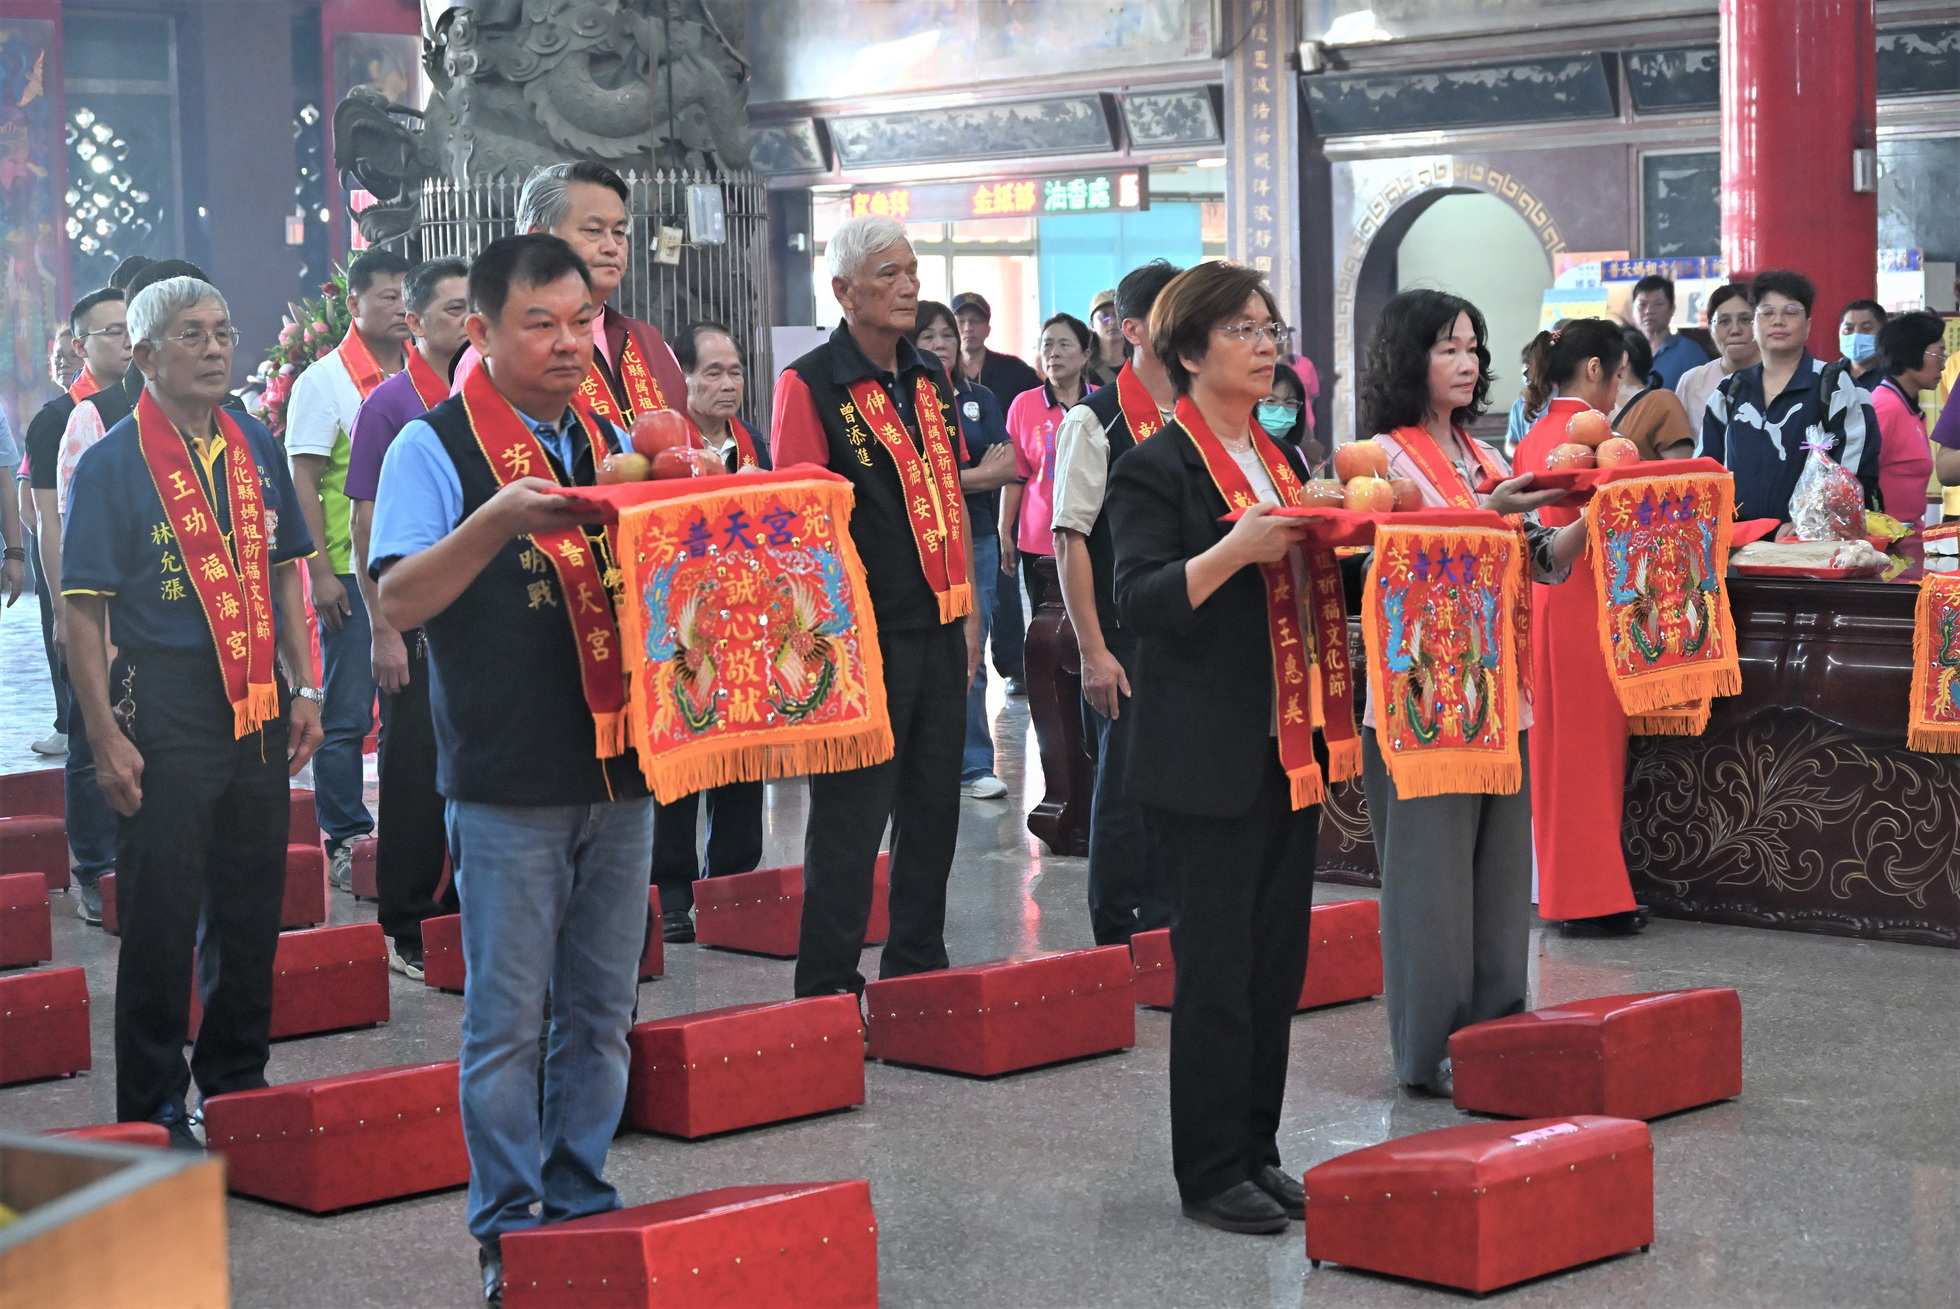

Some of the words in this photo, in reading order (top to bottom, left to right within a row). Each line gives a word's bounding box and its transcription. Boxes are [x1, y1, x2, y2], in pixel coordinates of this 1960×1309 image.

[840, 401, 874, 467] 曾添進
[866, 389, 939, 554] 伸港福安宮
[915, 377, 961, 543] 彰化縣媽祖祈福文化節
[151, 521, 187, 601] 林允漲
[168, 470, 248, 660] 王功福海宮
[233, 445, 271, 641] 彰化縣媽祖祈福文化節
[517, 533, 557, 610] 明戰
